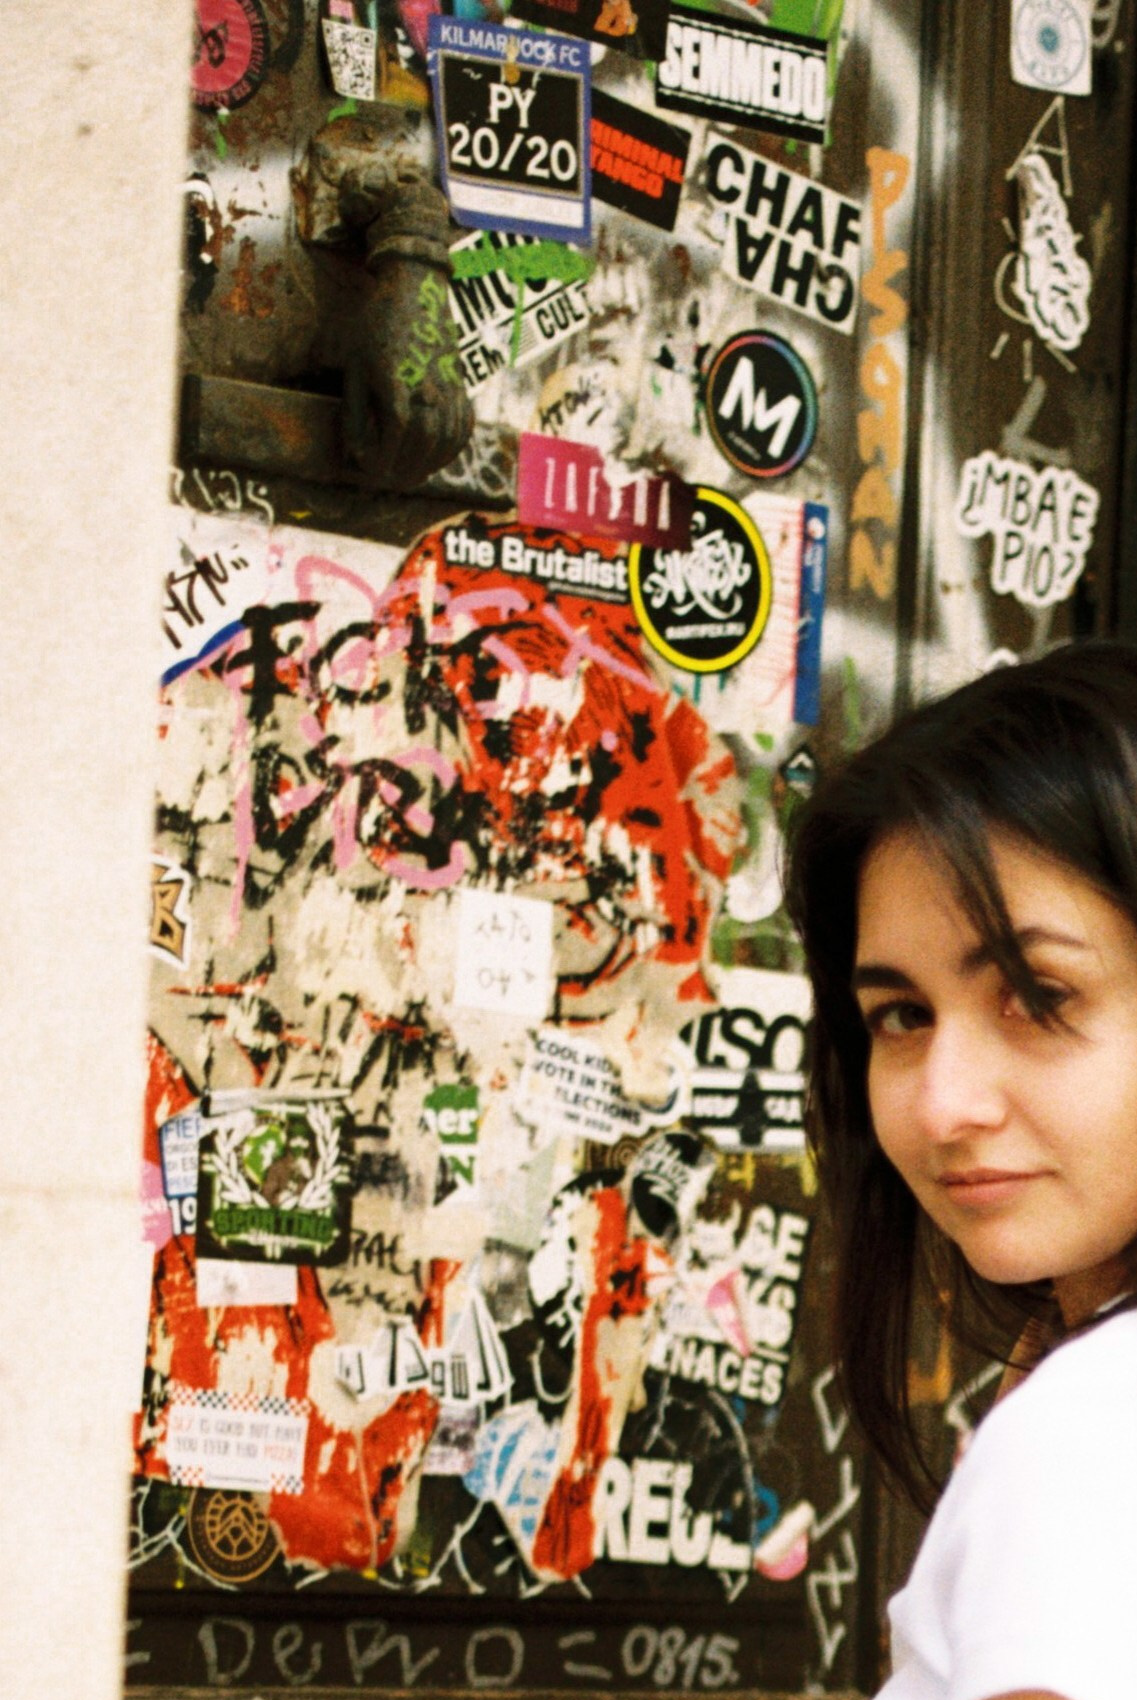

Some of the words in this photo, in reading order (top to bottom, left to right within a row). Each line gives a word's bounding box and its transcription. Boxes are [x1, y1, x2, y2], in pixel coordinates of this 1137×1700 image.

[559, 47, 582, 67] FC
[658, 22, 828, 121] SEMMEDO
[488, 83, 537, 128] PY
[449, 122, 579, 182] 20/20
[444, 528, 496, 568] the
[500, 537, 628, 592] Brutalist
[536, 1038, 581, 1064] COOL
[532, 1060, 577, 1085] VOTE
[216, 1207, 335, 1240] SPORTING
